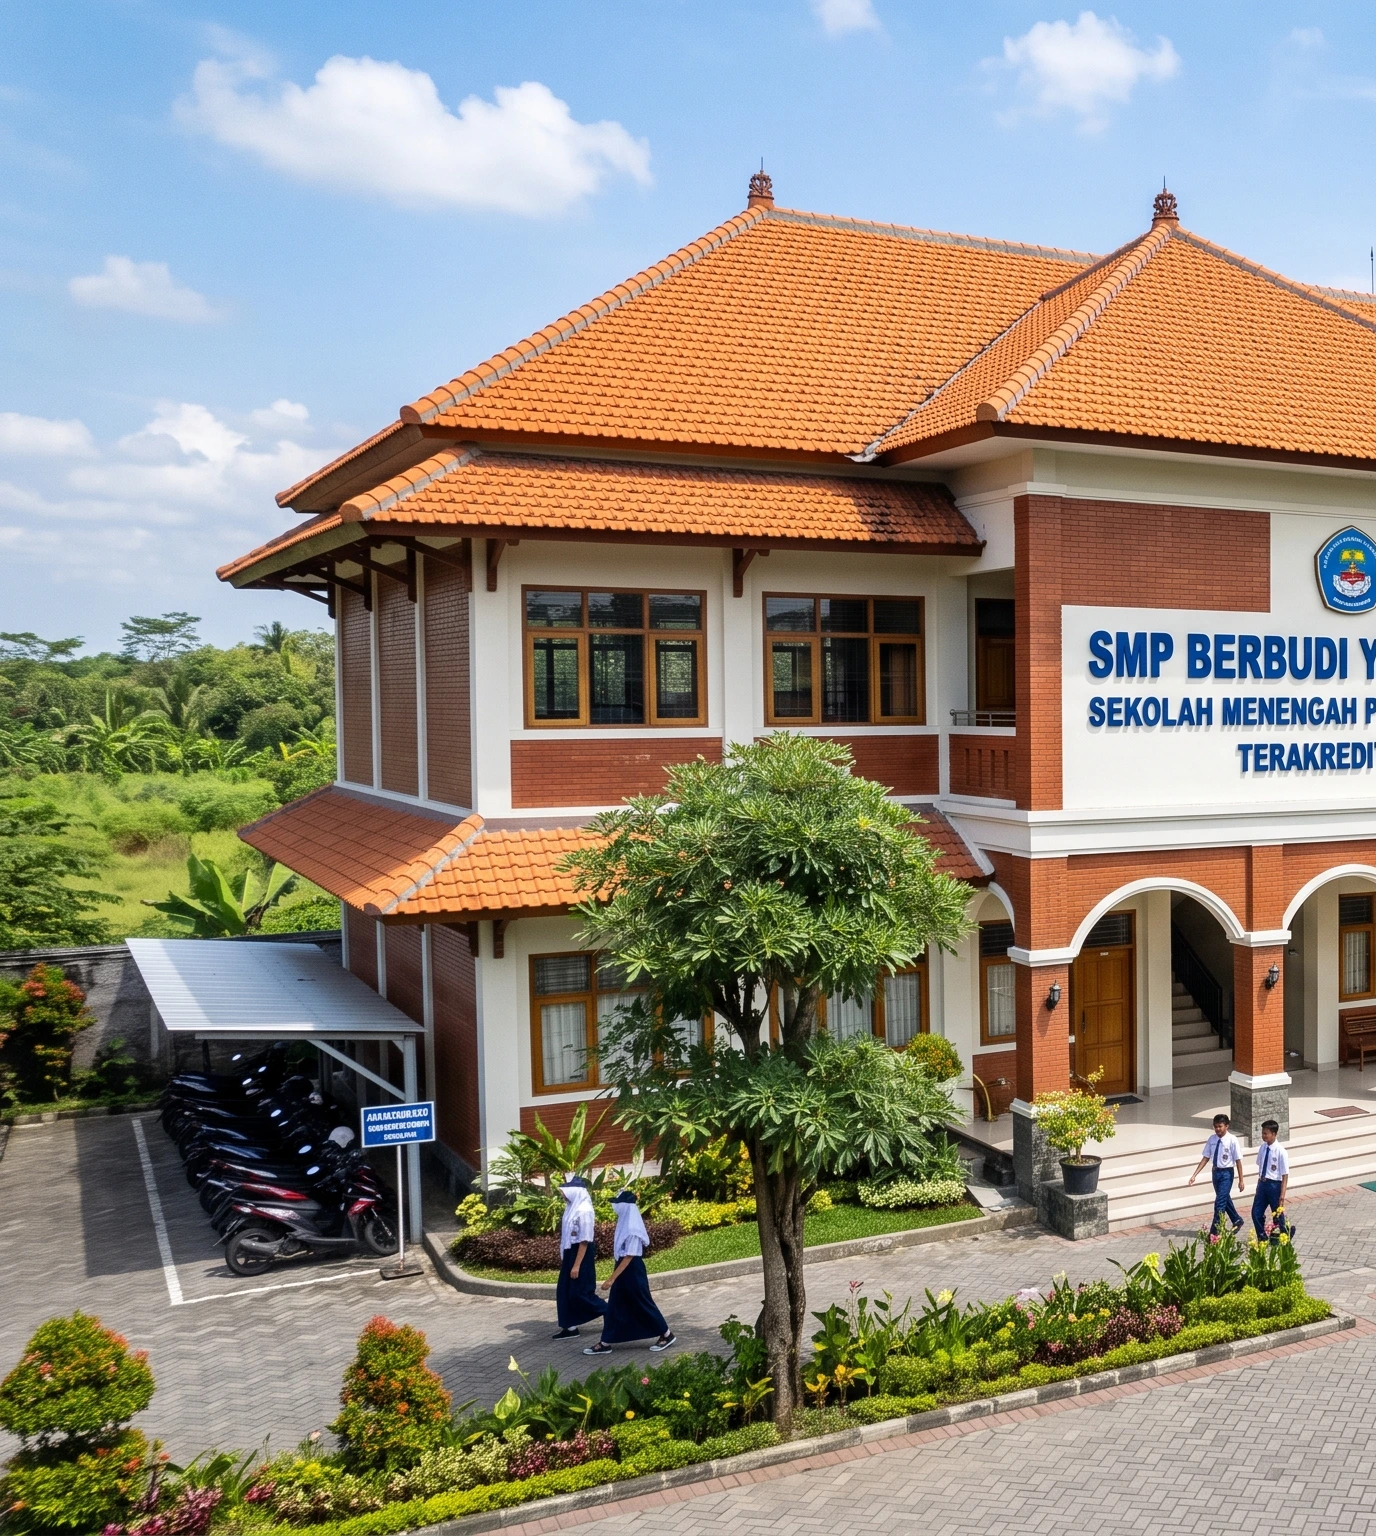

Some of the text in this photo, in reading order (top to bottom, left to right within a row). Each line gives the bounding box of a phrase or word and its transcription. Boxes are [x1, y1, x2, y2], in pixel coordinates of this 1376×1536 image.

[1088, 630, 1174, 679] SMP
[1187, 633, 1349, 680] BERBUDI
[1089, 696, 1213, 727] SEKOLAH
[1222, 697, 1357, 726] MENENGAH
